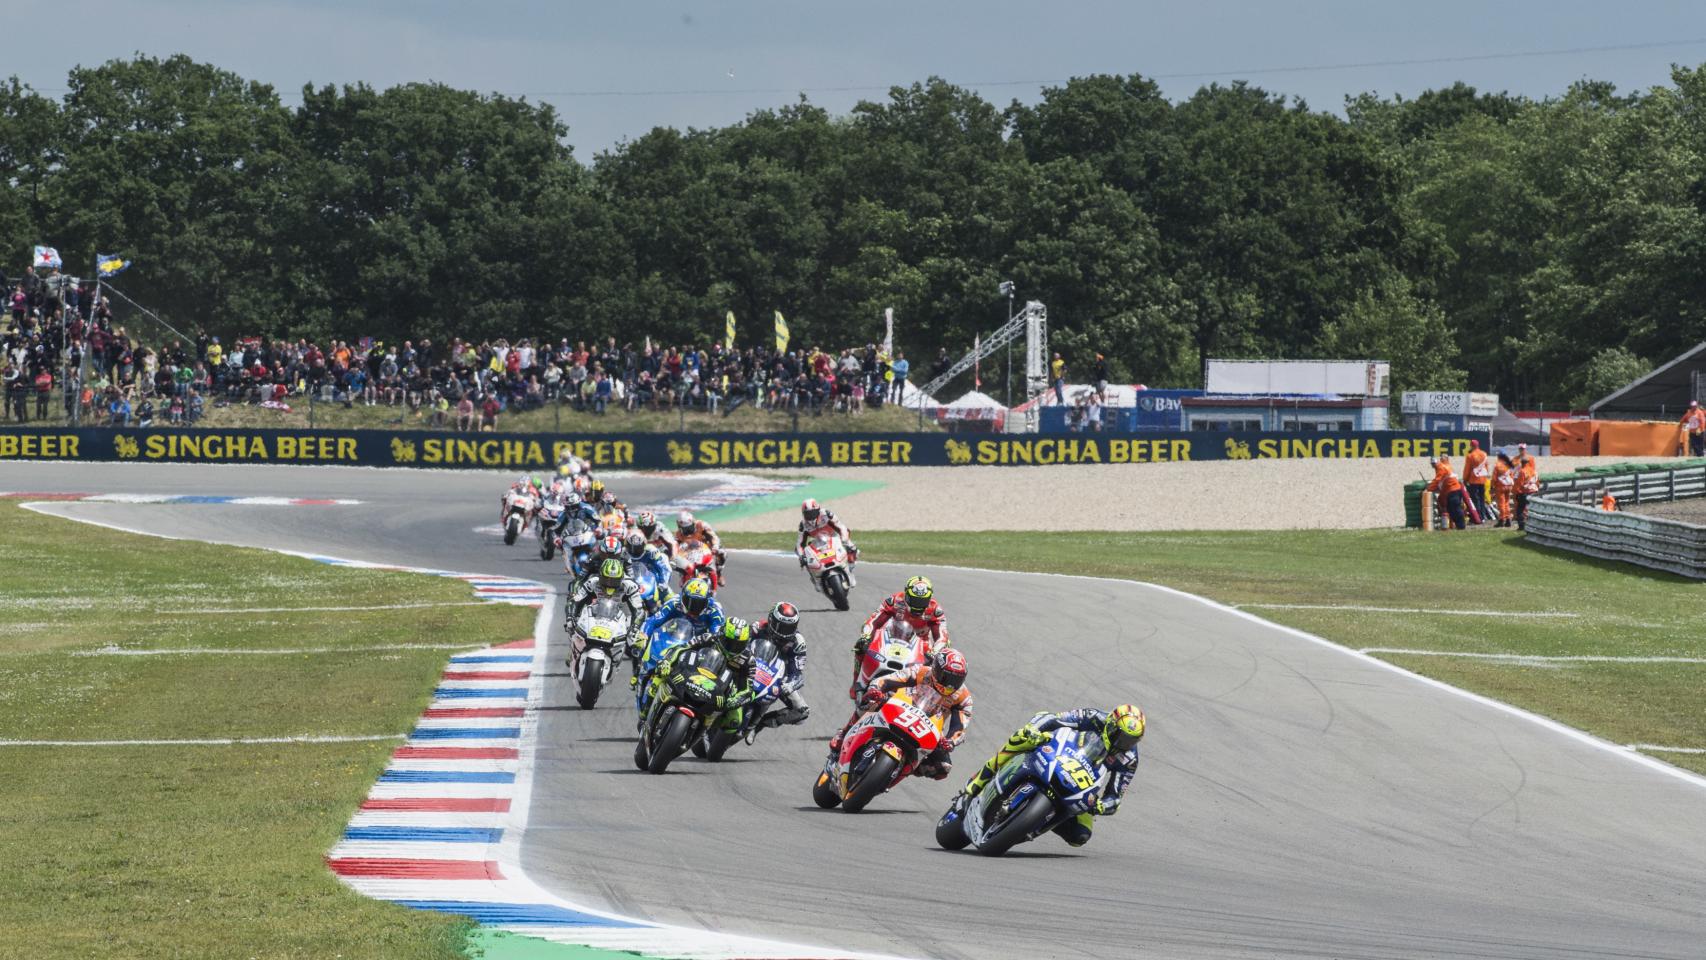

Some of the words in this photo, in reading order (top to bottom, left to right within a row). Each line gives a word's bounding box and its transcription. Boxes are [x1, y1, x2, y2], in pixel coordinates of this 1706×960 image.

[1155, 396, 1182, 412] Bav
[1429, 391, 1462, 402] riders
[0, 434, 79, 457] BEER
[144, 434, 268, 460] SINGHA
[277, 436, 358, 460] BEER
[423, 439, 545, 465] SINGHA
[699, 440, 822, 465] SINGHA
[831, 440, 912, 464] BEER
[977, 439, 1100, 465] SINGHA
[1109, 439, 1191, 463] BEER
[1257, 438, 1381, 460] SINGHA
[893, 711, 932, 739] 93
[1055, 754, 1095, 790] 46
[1064, 746, 1097, 781] movistar
